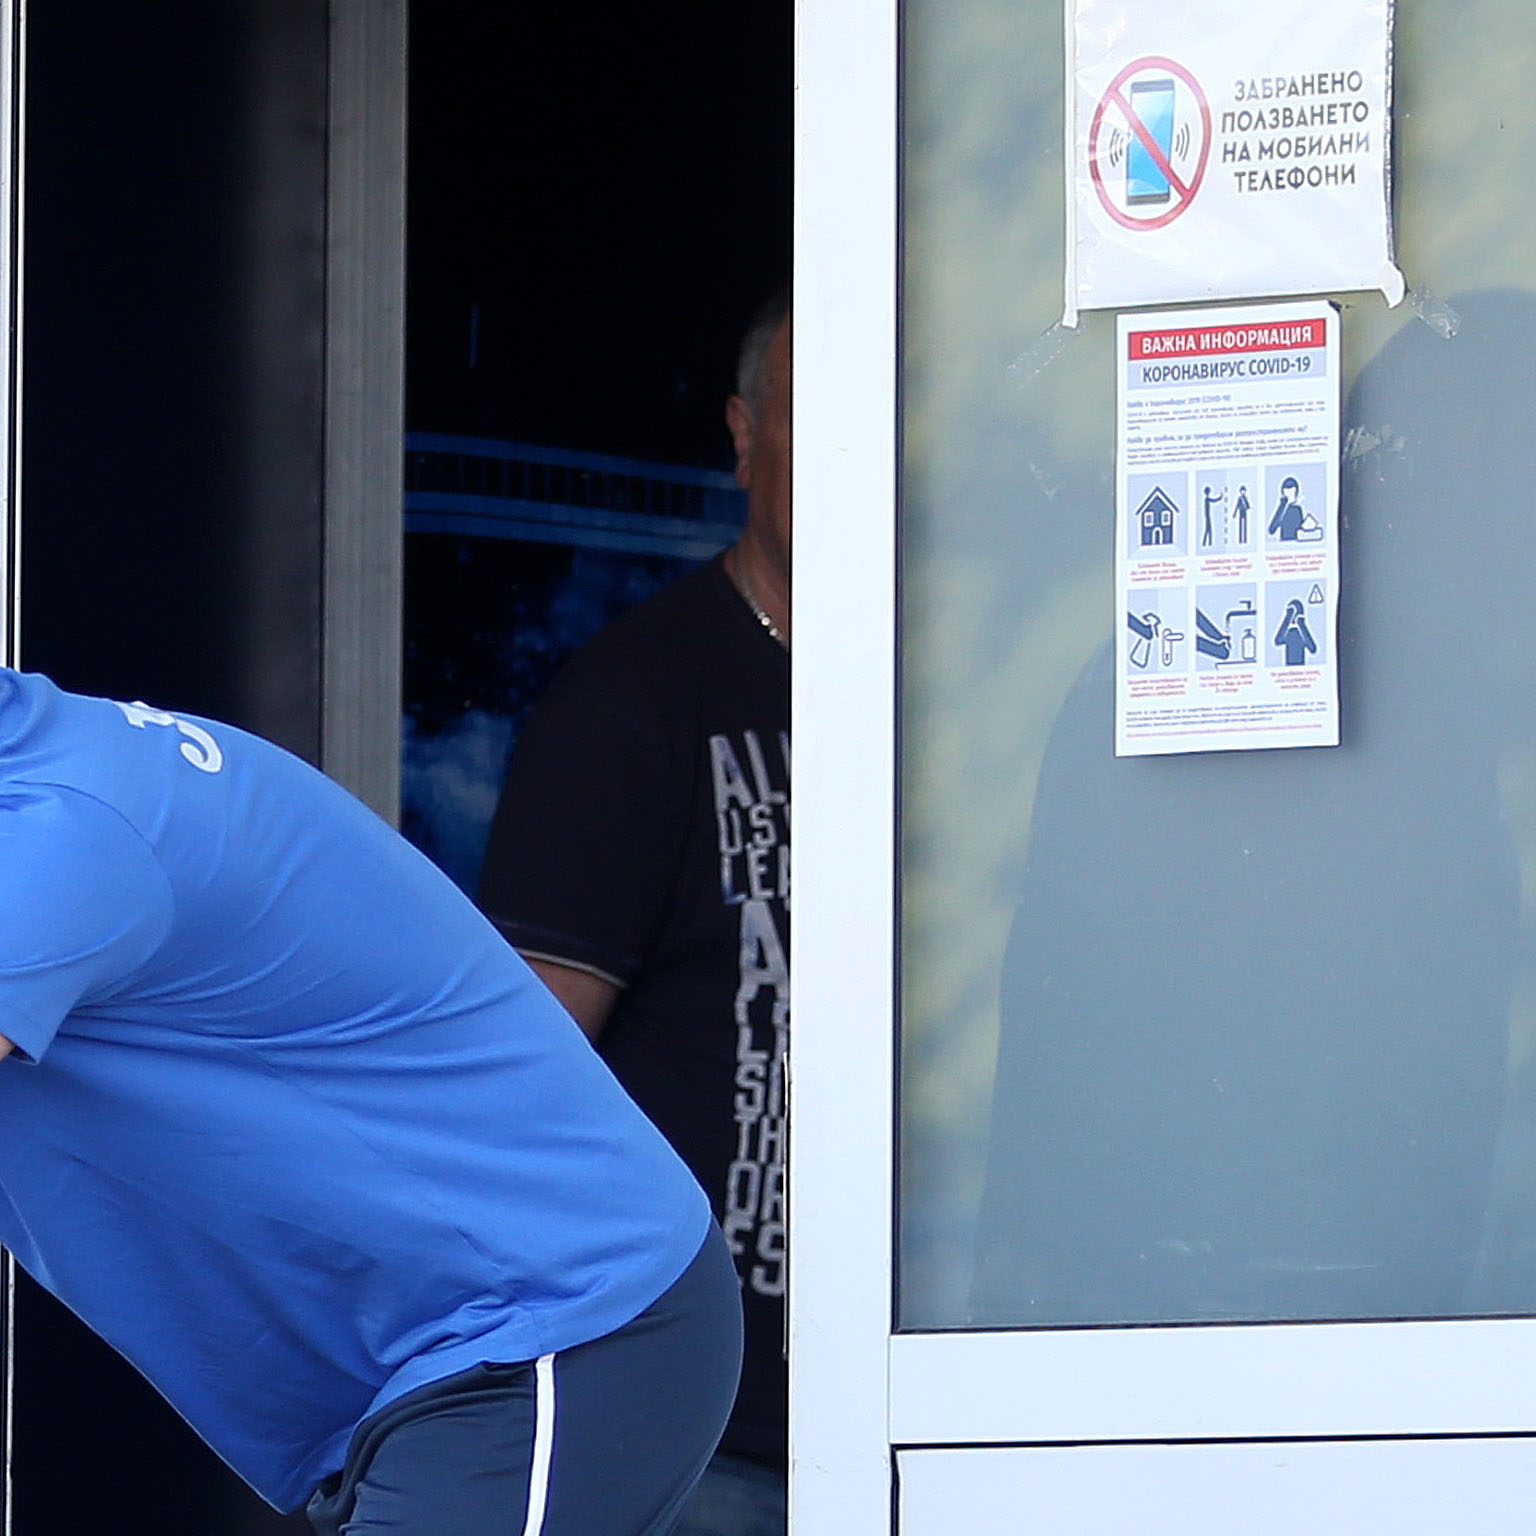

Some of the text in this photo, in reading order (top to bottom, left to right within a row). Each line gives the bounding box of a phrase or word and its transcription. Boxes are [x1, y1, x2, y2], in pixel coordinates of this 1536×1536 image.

[1234, 70, 1363, 102] ЗАБРАНЕНО
[1221, 101, 1369, 134] ПОЛЗВАНЕТО
[1222, 131, 1370, 163] НА МОБИЛНИ
[1234, 164, 1356, 193] ТЕЛЕФОНИ
[1141, 325, 1312, 355] ВАЖНА ИНФОРМАЦИЯ
[1142, 356, 1311, 383] КОРОНАВИРУС COVID-19
